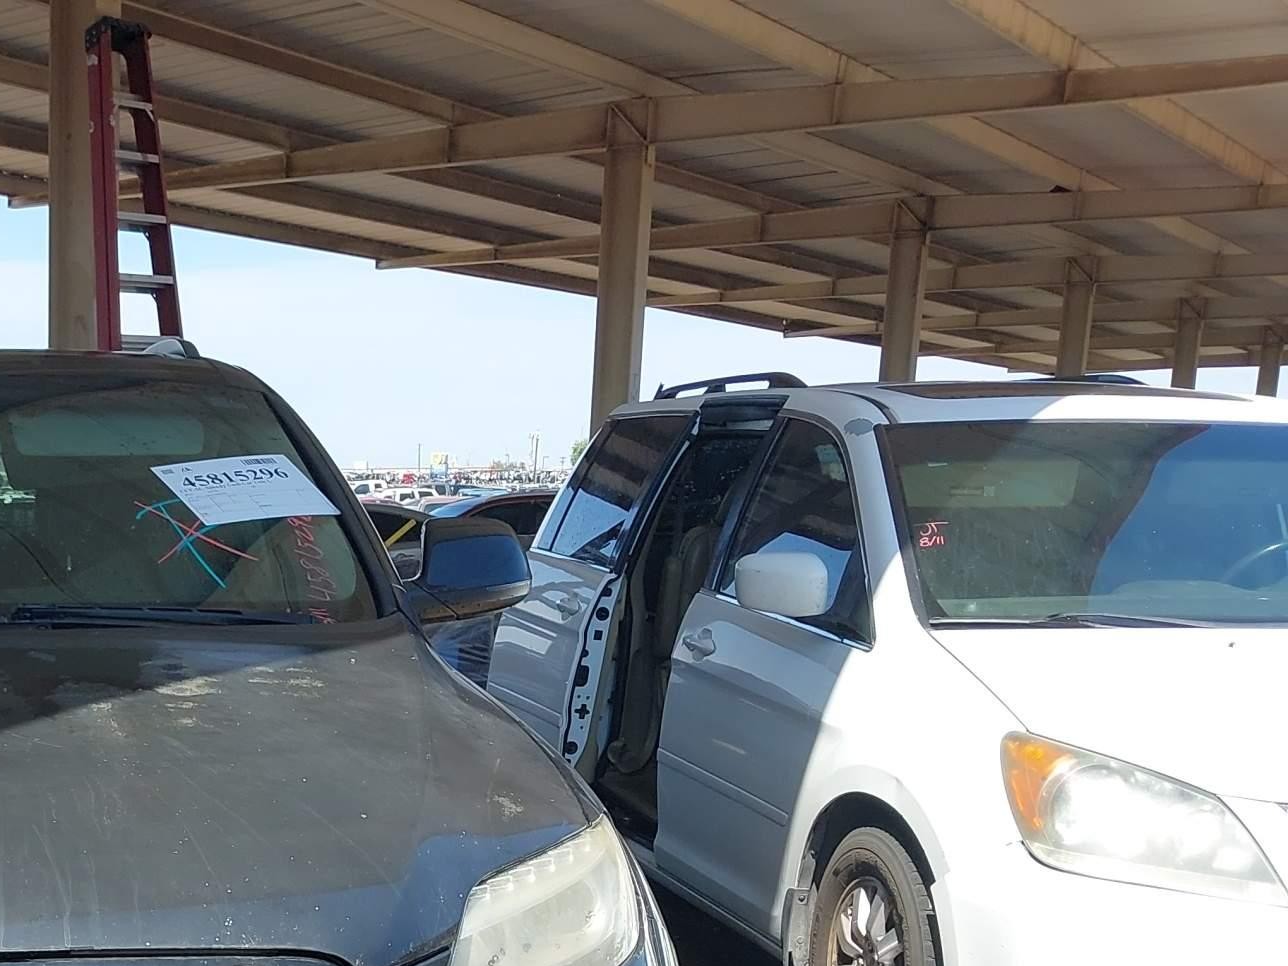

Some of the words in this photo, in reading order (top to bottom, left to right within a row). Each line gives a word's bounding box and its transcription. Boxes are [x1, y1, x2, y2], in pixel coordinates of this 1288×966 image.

[182, 466, 289, 488] 45815296
[919, 535, 945, 547] 8/11
[287, 515, 337, 601] 4581529
